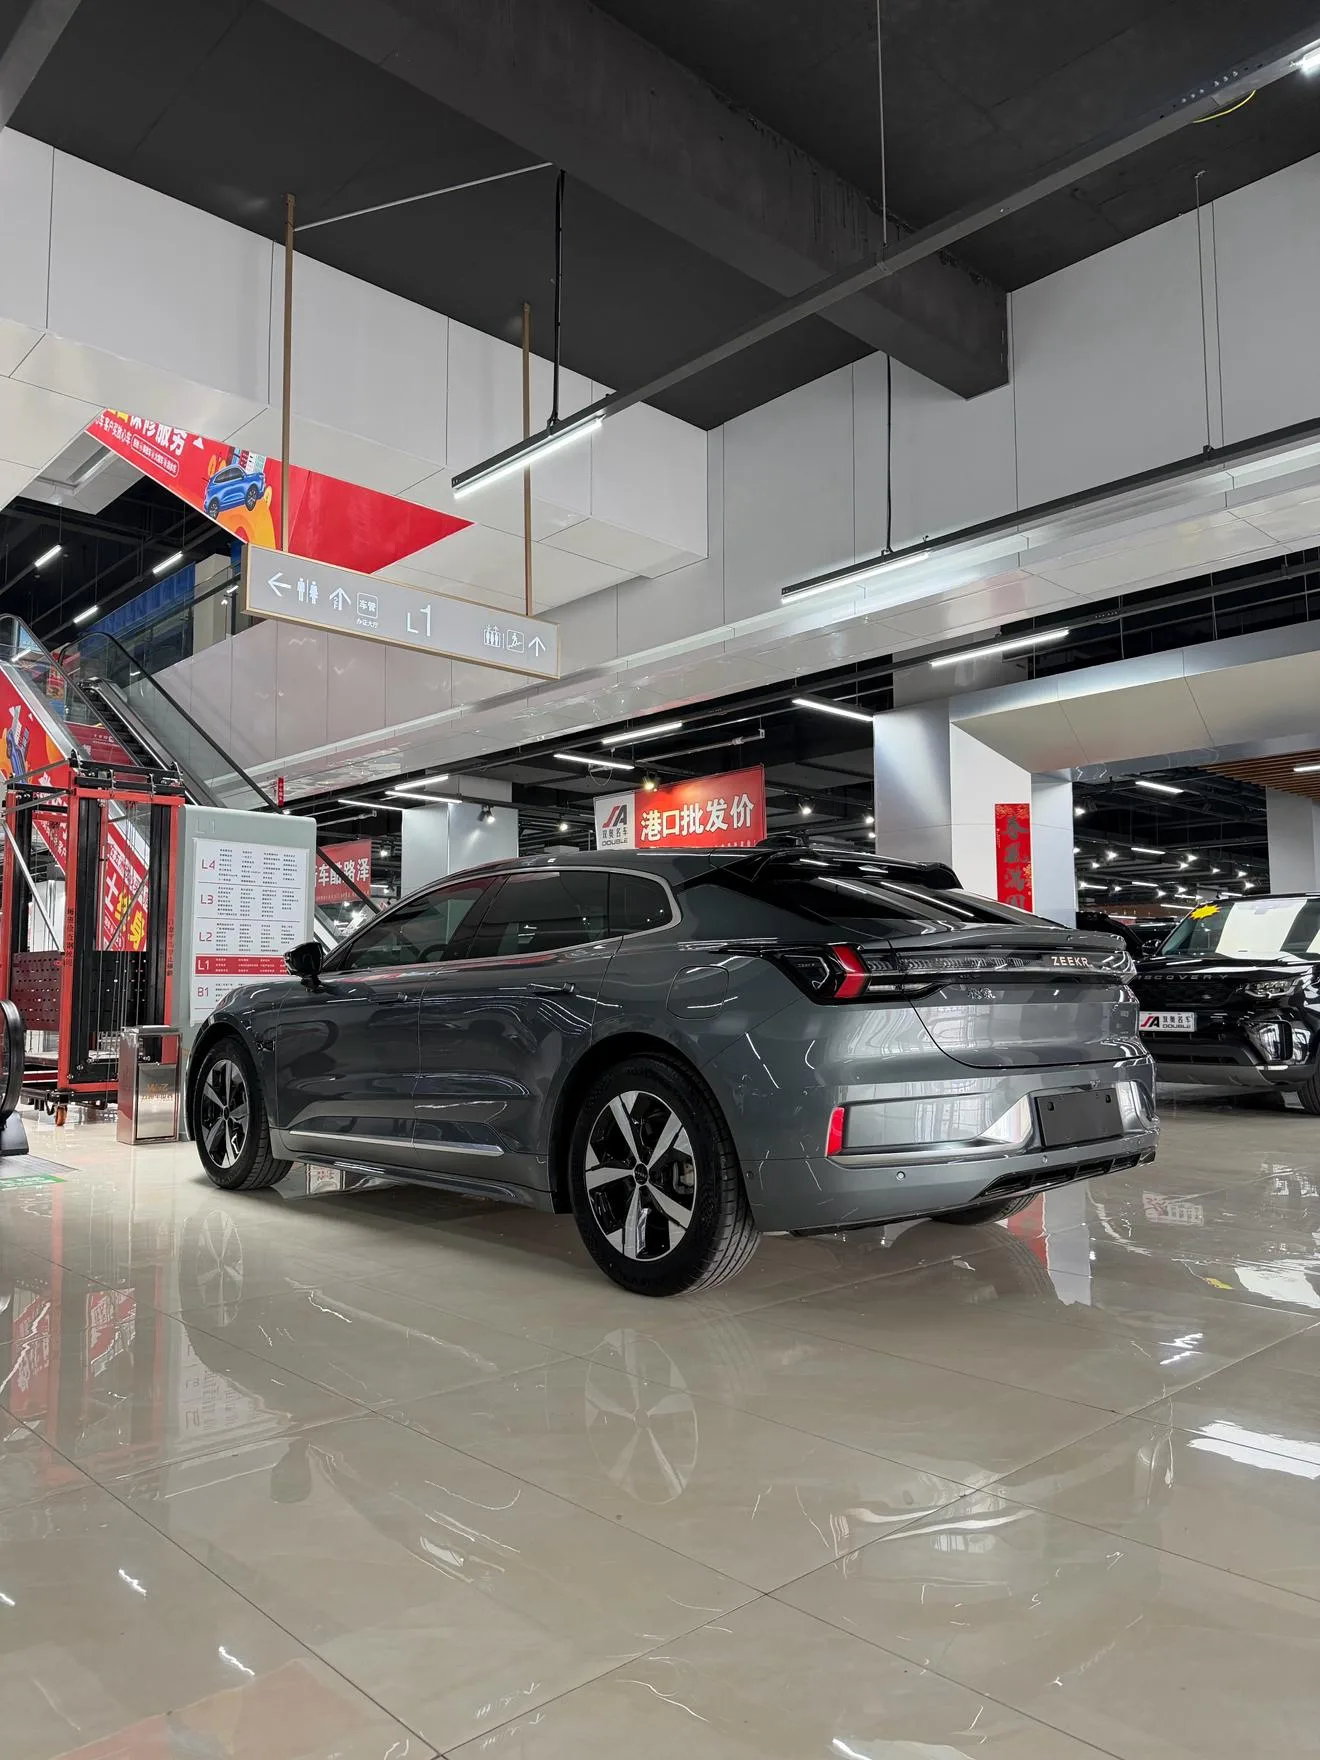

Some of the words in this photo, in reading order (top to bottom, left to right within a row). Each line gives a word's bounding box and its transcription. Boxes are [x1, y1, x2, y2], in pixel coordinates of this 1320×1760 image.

[359, 599, 376, 612] 车管
[406, 604, 431, 637] L1
[640, 793, 755, 842] 港口批发价
[601, 838, 628, 847] DOUBLE
[201, 858, 216, 870] L4
[314, 858, 370, 887] 车酷路泽
[200, 894, 214, 905] L3
[199, 931, 213, 942] L2
[197, 959, 210, 971] L1
[1051, 956, 1089, 967] ZEEKR
[197, 986, 209, 997] B1
